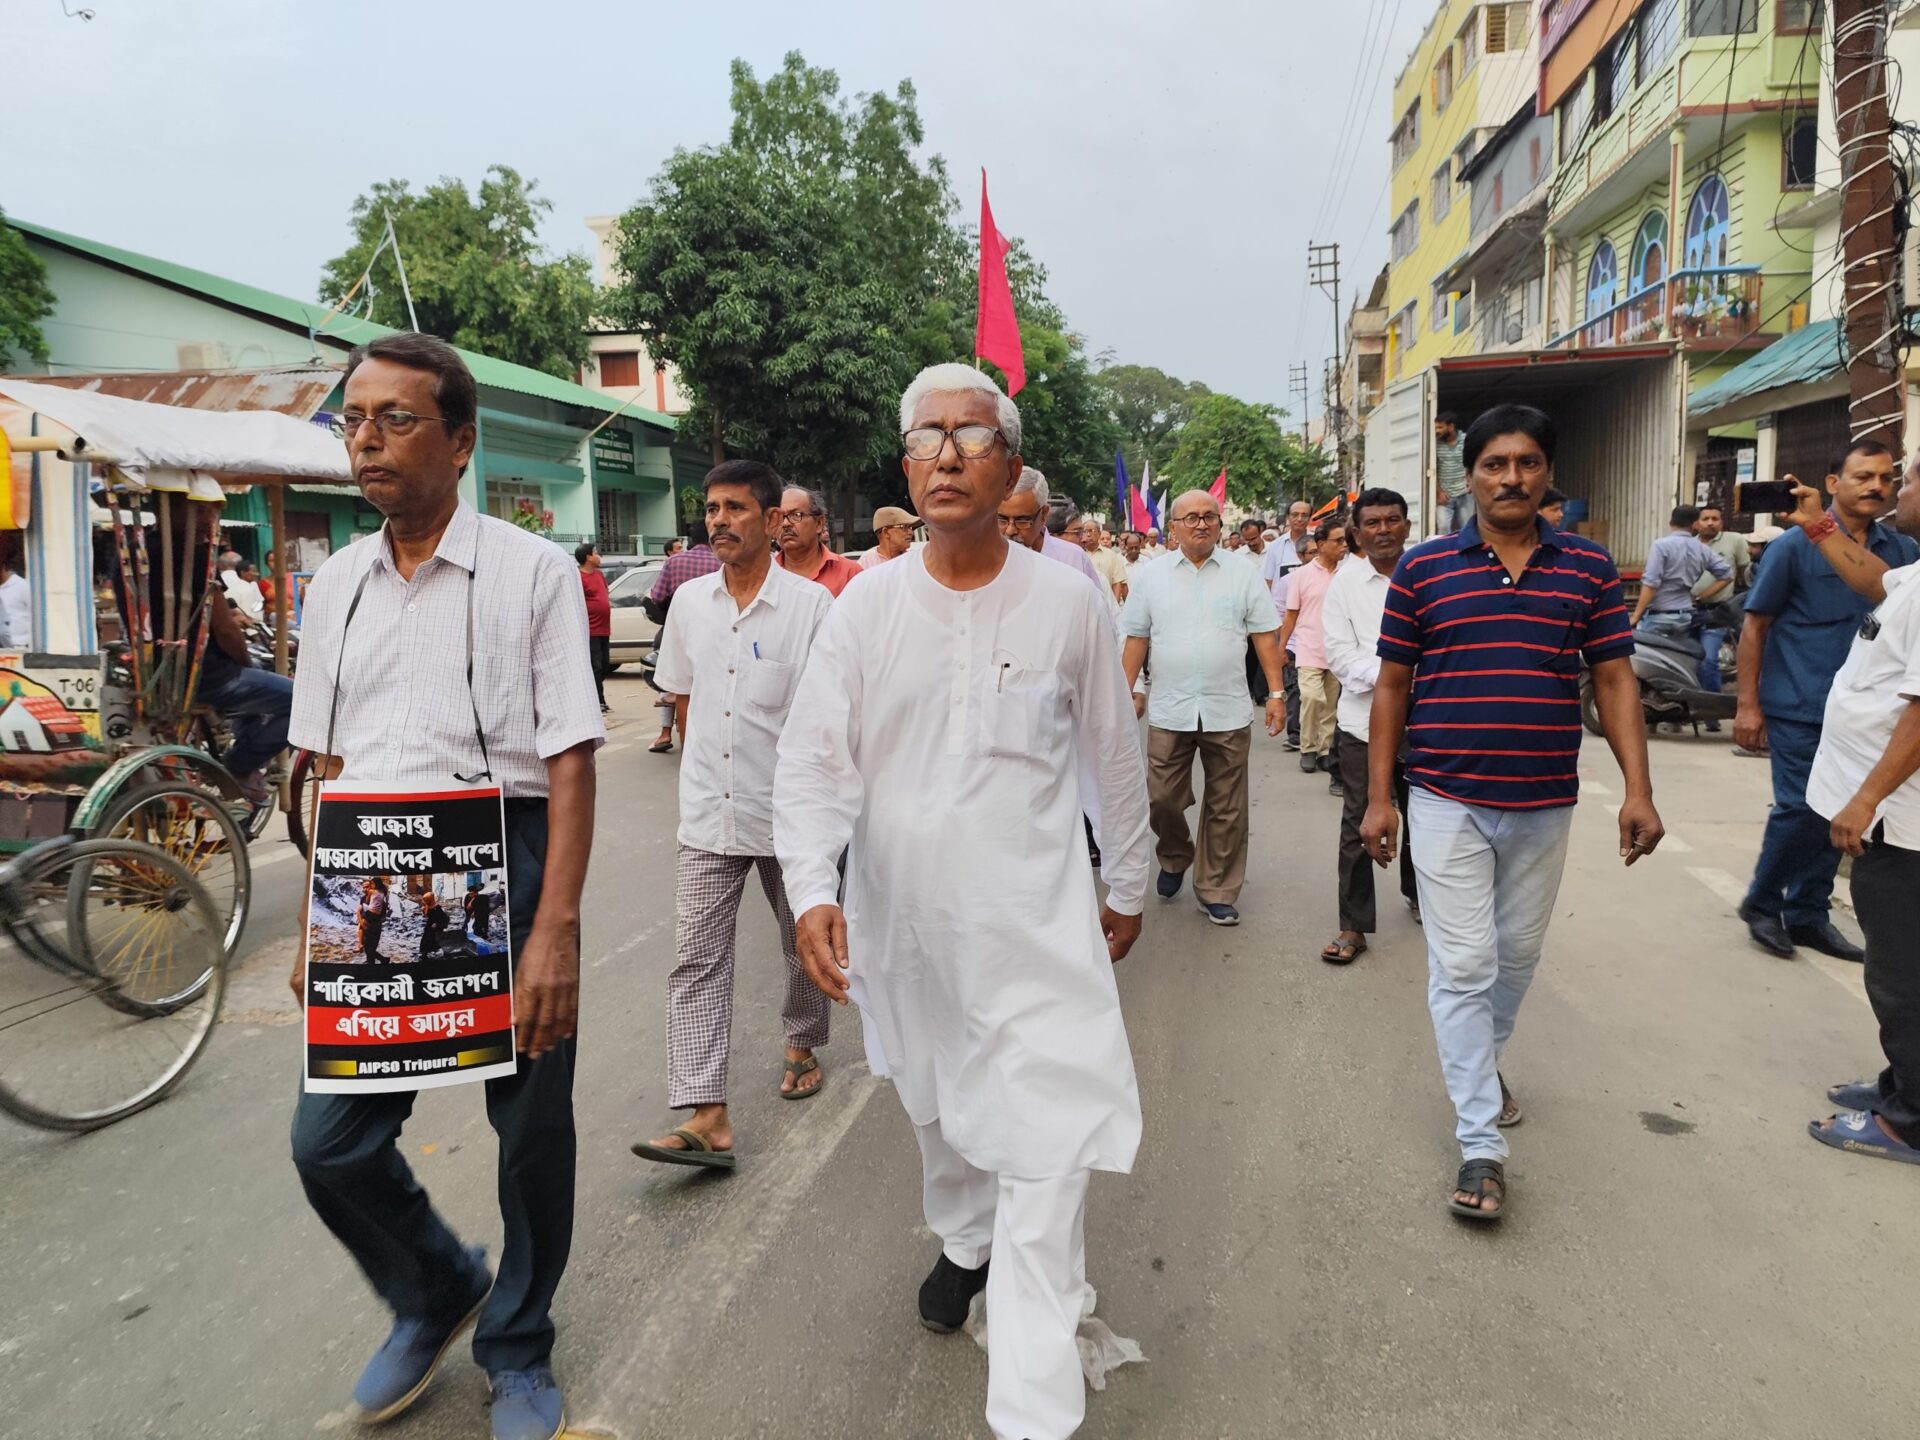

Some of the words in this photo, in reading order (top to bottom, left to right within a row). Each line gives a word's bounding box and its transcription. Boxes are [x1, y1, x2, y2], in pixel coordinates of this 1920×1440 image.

[357, 814, 434, 838] আক্রান্ত
[316, 842, 433, 872] গাজাবাসীদের
[442, 842, 500, 868] পাশে
[313, 974, 415, 1006] শান্তিকামী
[422, 971, 500, 998] জনগণ
[336, 1009, 400, 1040] এগিয়ে
[407, 1008, 475, 1038] আসুন
[358, 1060, 401, 1075] AIPSO
[403, 1056, 458, 1072] Tripura
